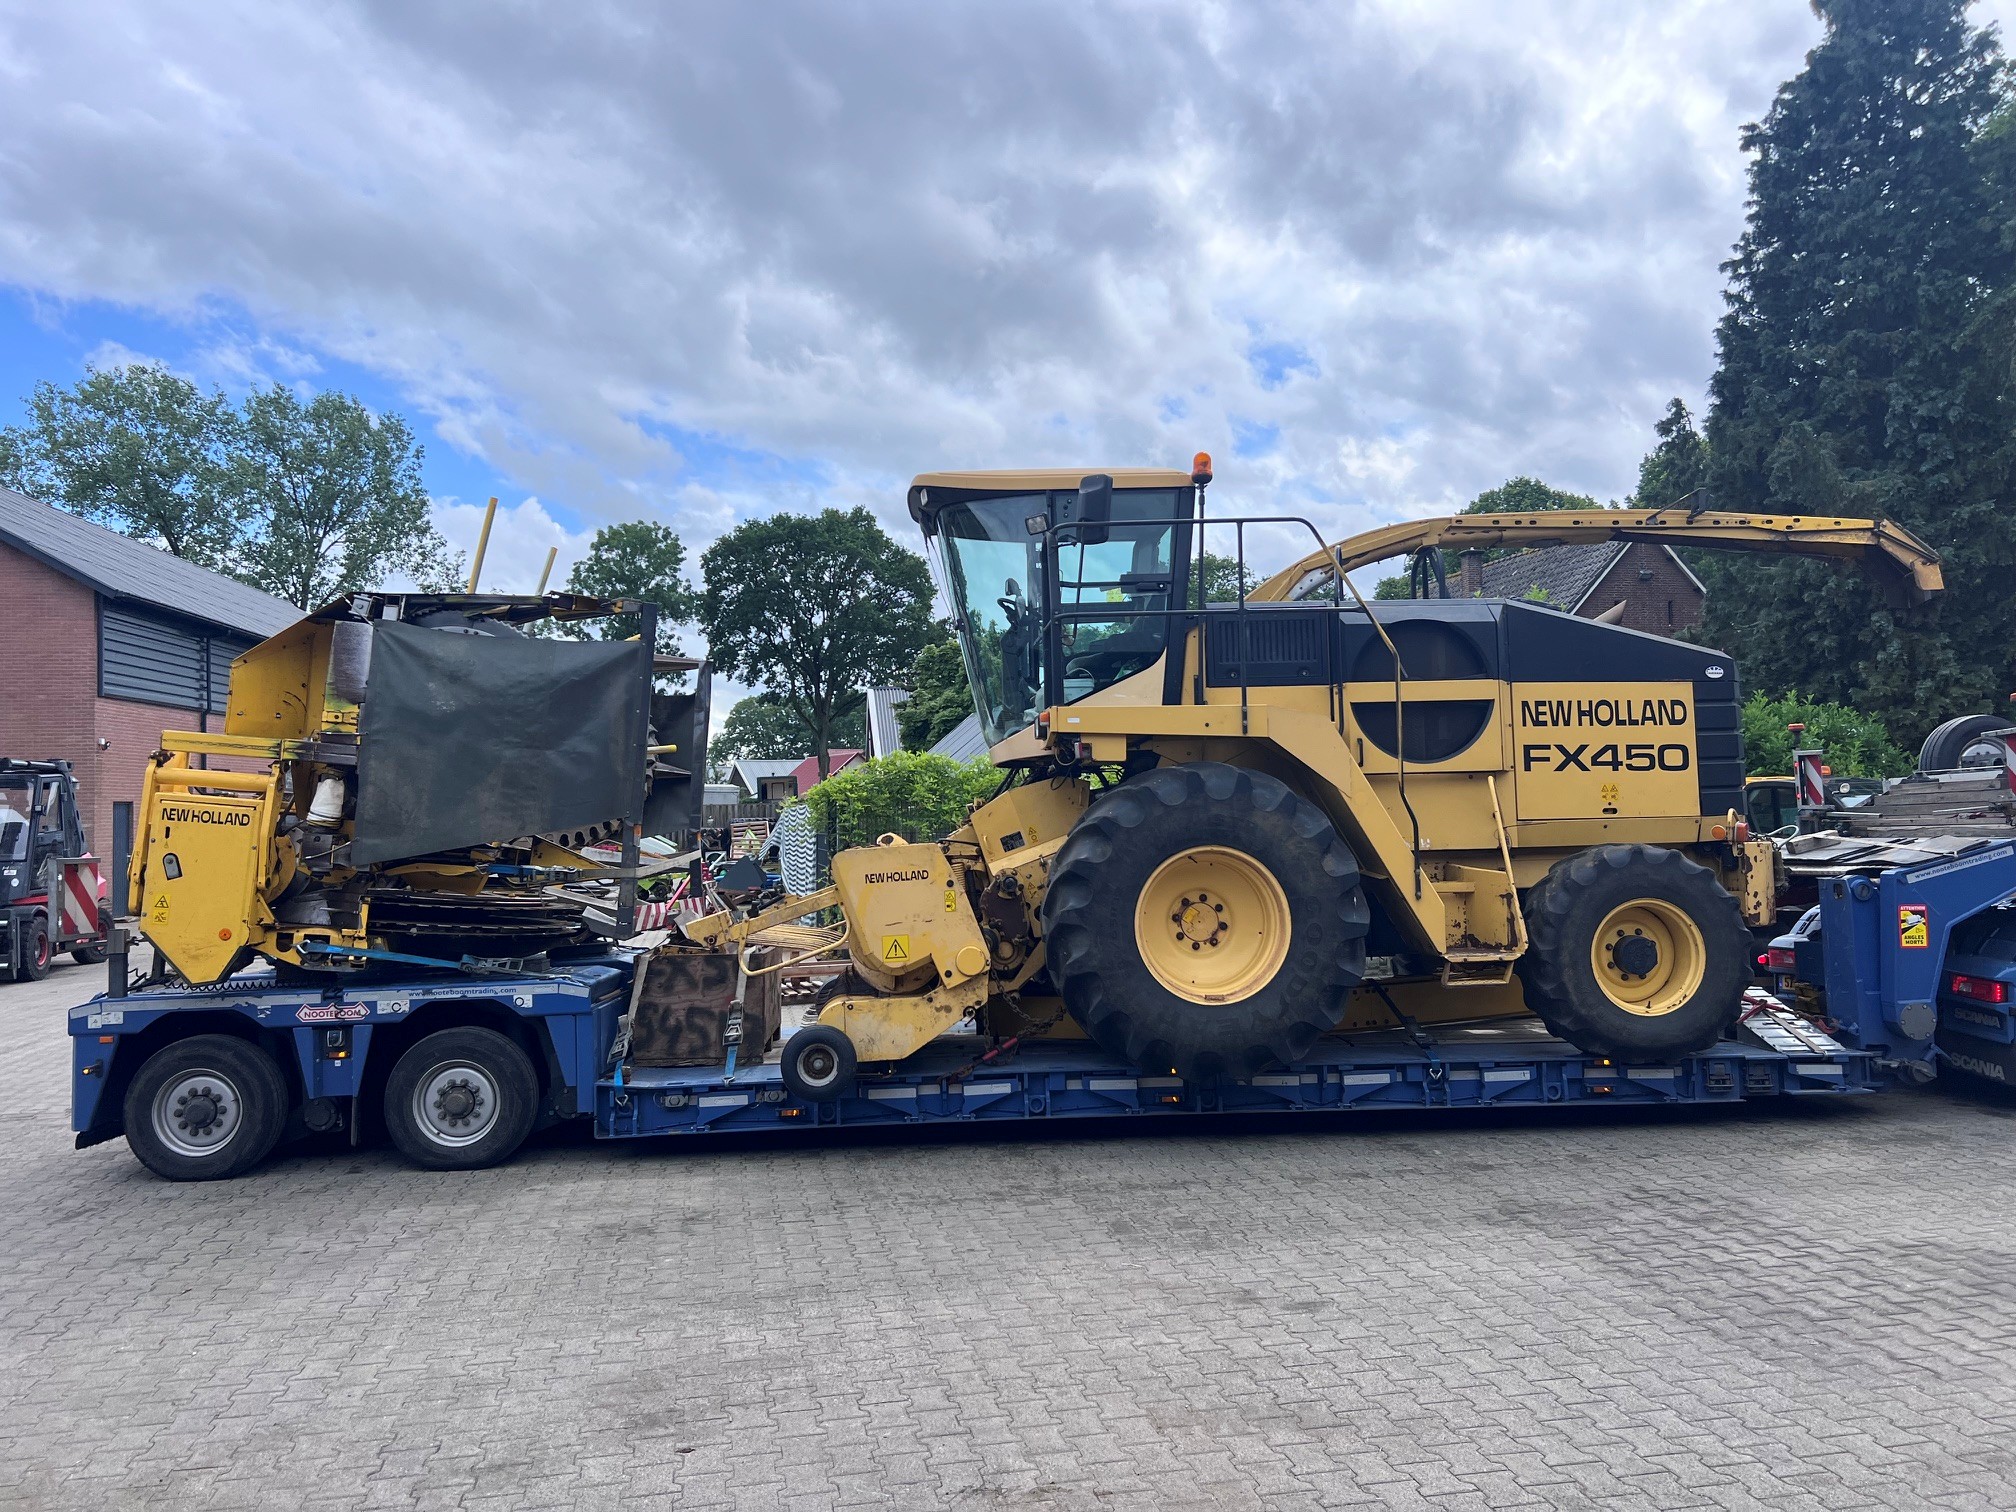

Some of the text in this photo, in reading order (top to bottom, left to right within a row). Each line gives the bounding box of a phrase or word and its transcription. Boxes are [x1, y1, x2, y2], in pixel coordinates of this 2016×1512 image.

[1521, 699, 1688, 727] NEW HOLLAND
[1522, 744, 1690, 772] FX450
[162, 807, 251, 826] NEW HOLLAND
[864, 869, 929, 884] NEW HOLLAND
[1914, 849, 2008, 879] www.nooteboomtrading.com
[408, 986, 517, 997] wwooteboomtradin.com
[1951, 1052, 2006, 1081] SCANIA
